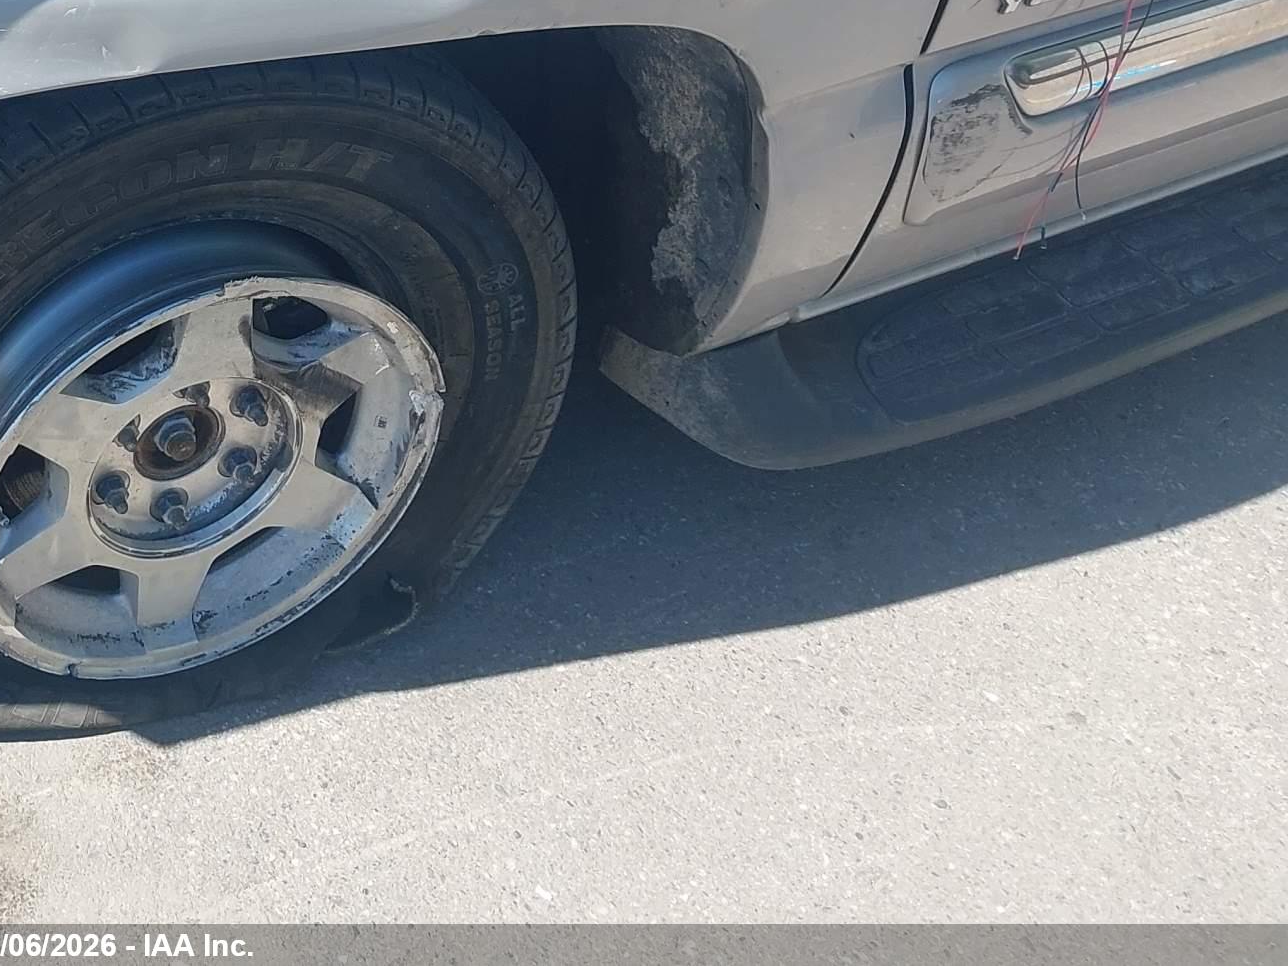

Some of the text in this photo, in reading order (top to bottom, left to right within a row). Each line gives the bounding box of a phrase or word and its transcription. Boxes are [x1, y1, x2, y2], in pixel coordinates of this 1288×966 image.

[248, 138, 395, 182] H/T
[508, 294, 527, 332] ALL
[484, 299, 503, 382] SEASON
